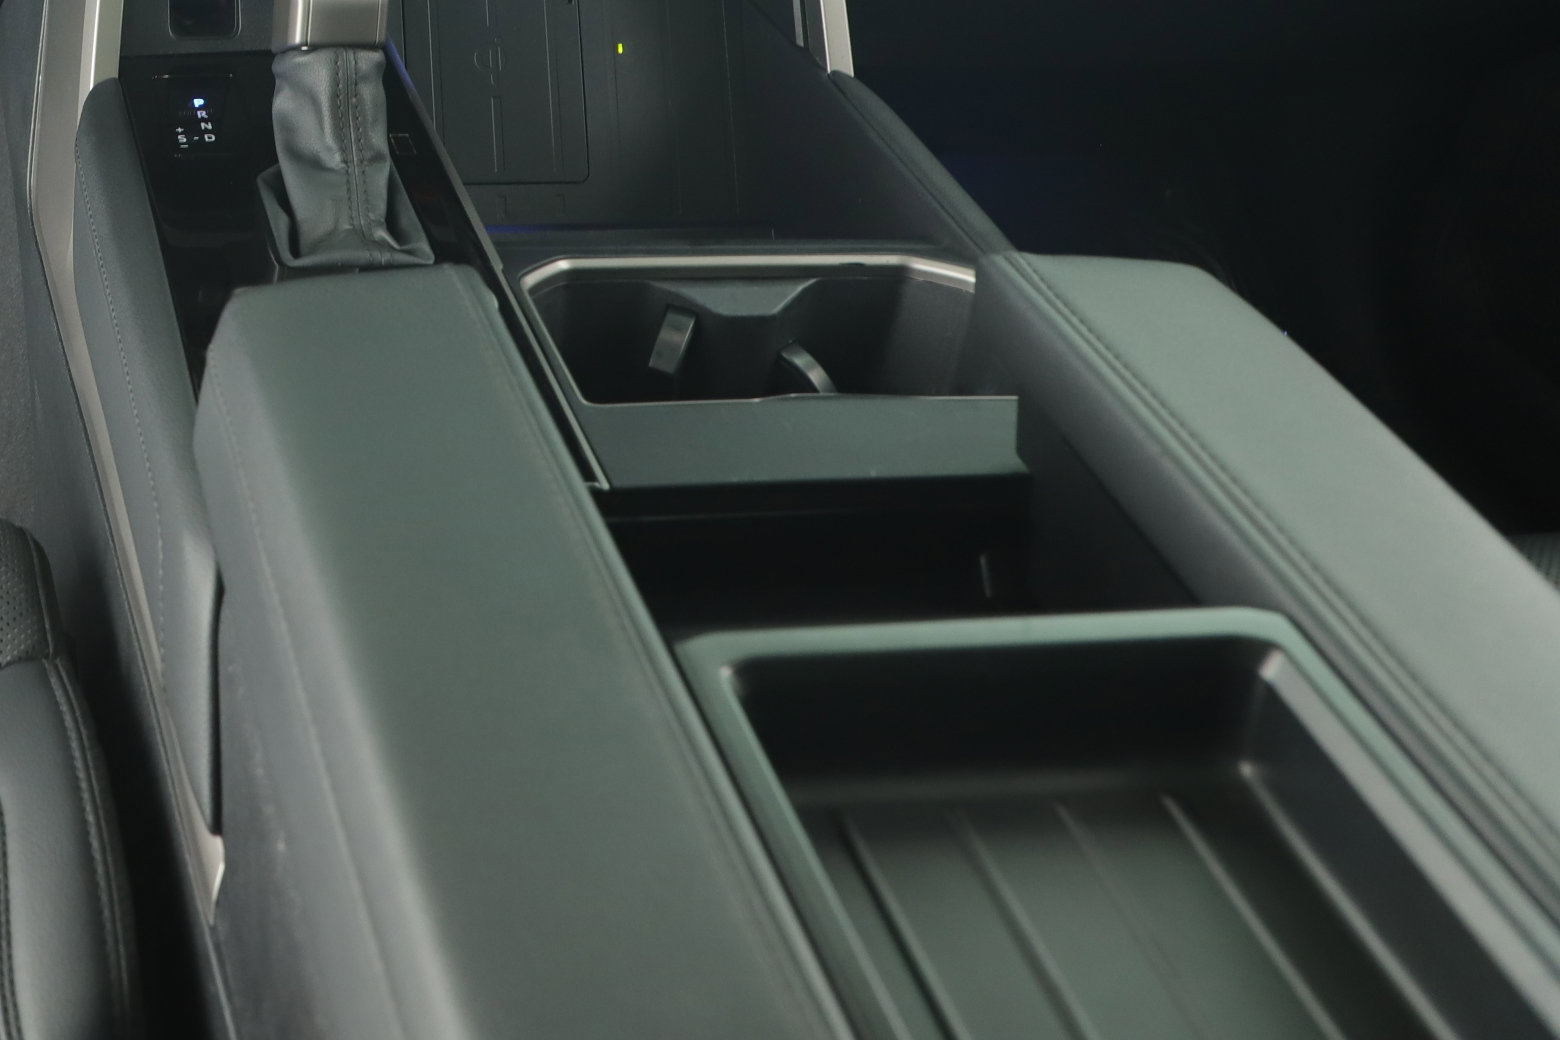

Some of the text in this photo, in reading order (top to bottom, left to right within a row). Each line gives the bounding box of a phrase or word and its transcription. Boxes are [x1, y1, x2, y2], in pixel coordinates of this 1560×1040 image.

[193, 98, 205, 108] P
[197, 110, 209, 119] R
[200, 121, 213, 131] N
[177, 134, 187, 143] S
[204, 133, 216, 143] D
